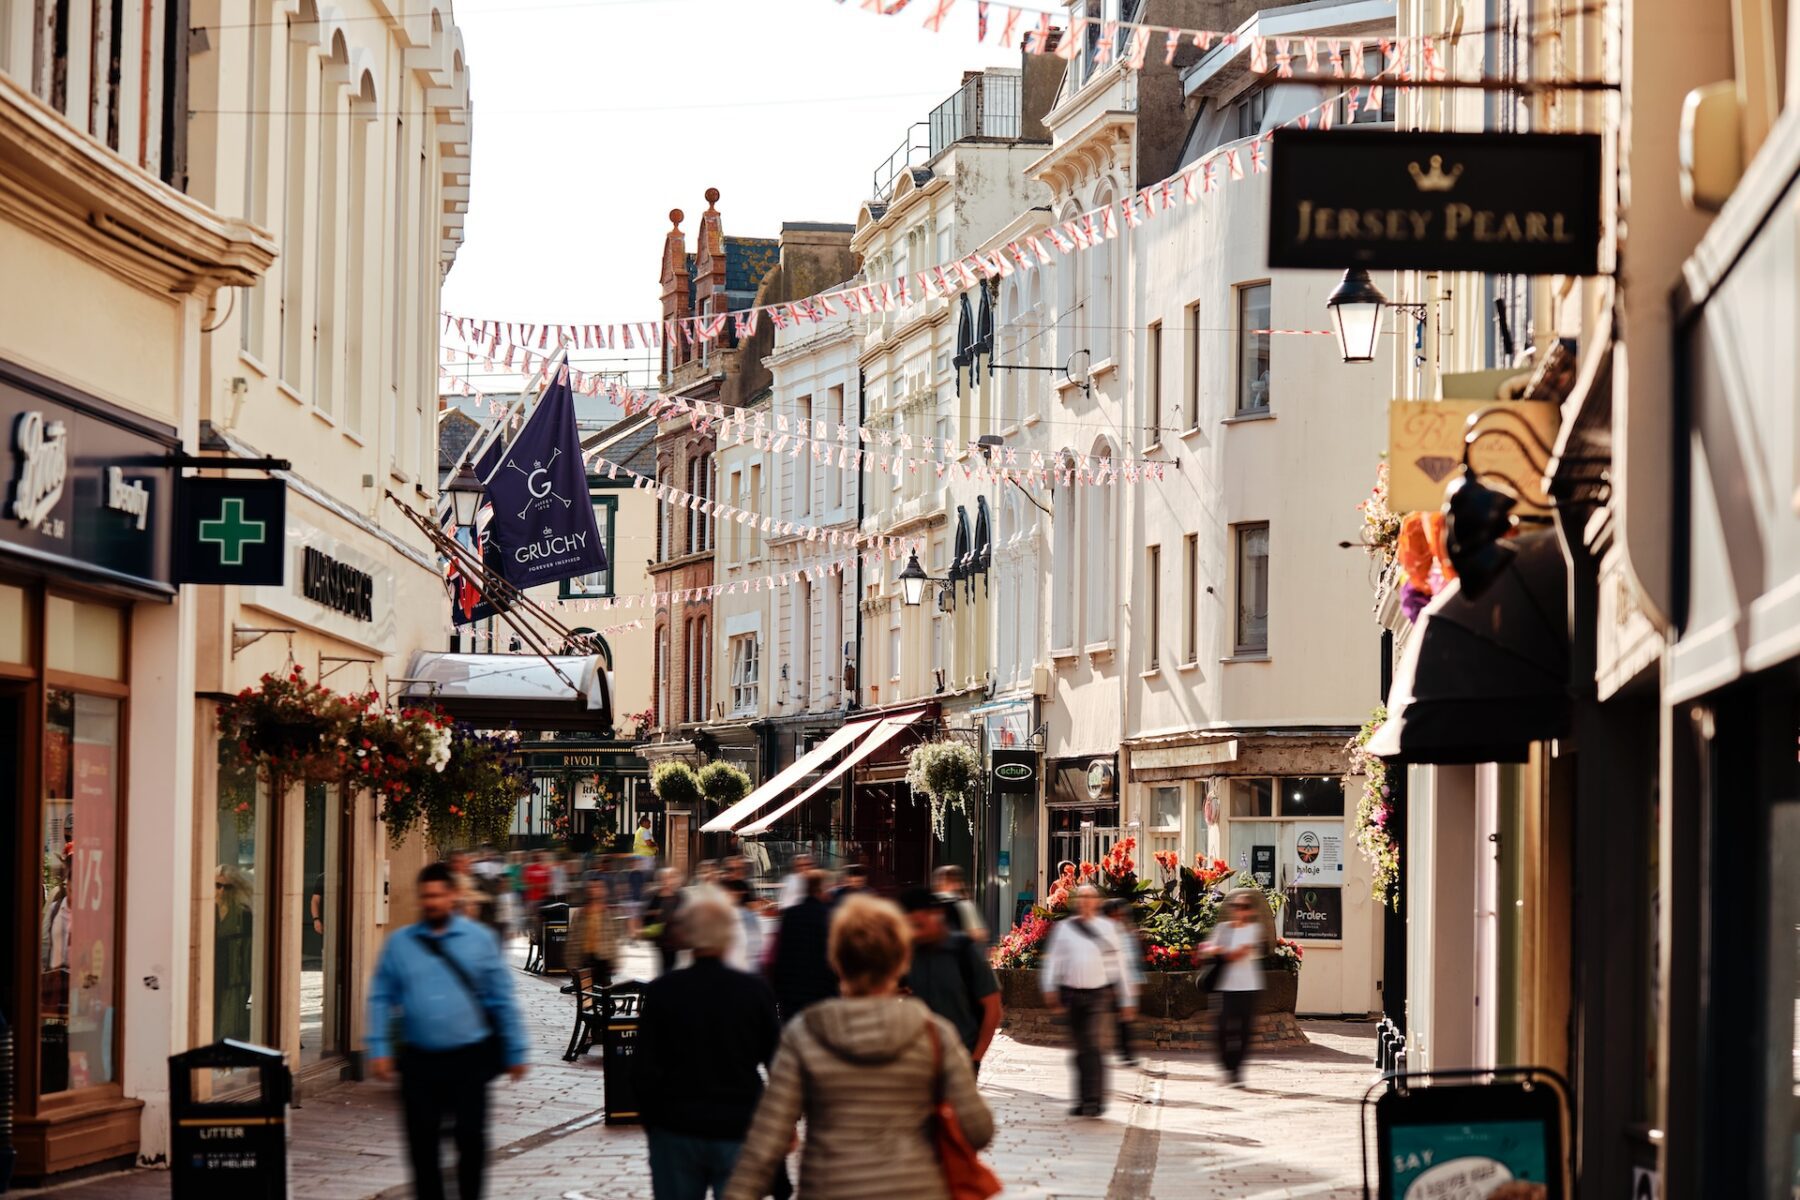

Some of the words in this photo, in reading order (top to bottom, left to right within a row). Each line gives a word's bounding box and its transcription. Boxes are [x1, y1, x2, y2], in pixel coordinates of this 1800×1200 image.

[1296, 200, 1433, 244] JERSEY
[1444, 202, 1575, 243] PEARL
[533, 460, 541, 468] de
[528, 468, 551, 498] G
[543, 526, 552, 535] de
[515, 530, 587, 563] GRUCHY
[528, 562, 554, 572] FOREVER
[554, 556, 581, 567] INSPIRED
[563, 755, 600, 766] RIVOLI
[1000, 766, 1027, 776] schuh
[1296, 910, 1328, 920] Prolec
[200, 1127, 245, 1139] LITTER
[1393, 1149, 1433, 1173] SAY
